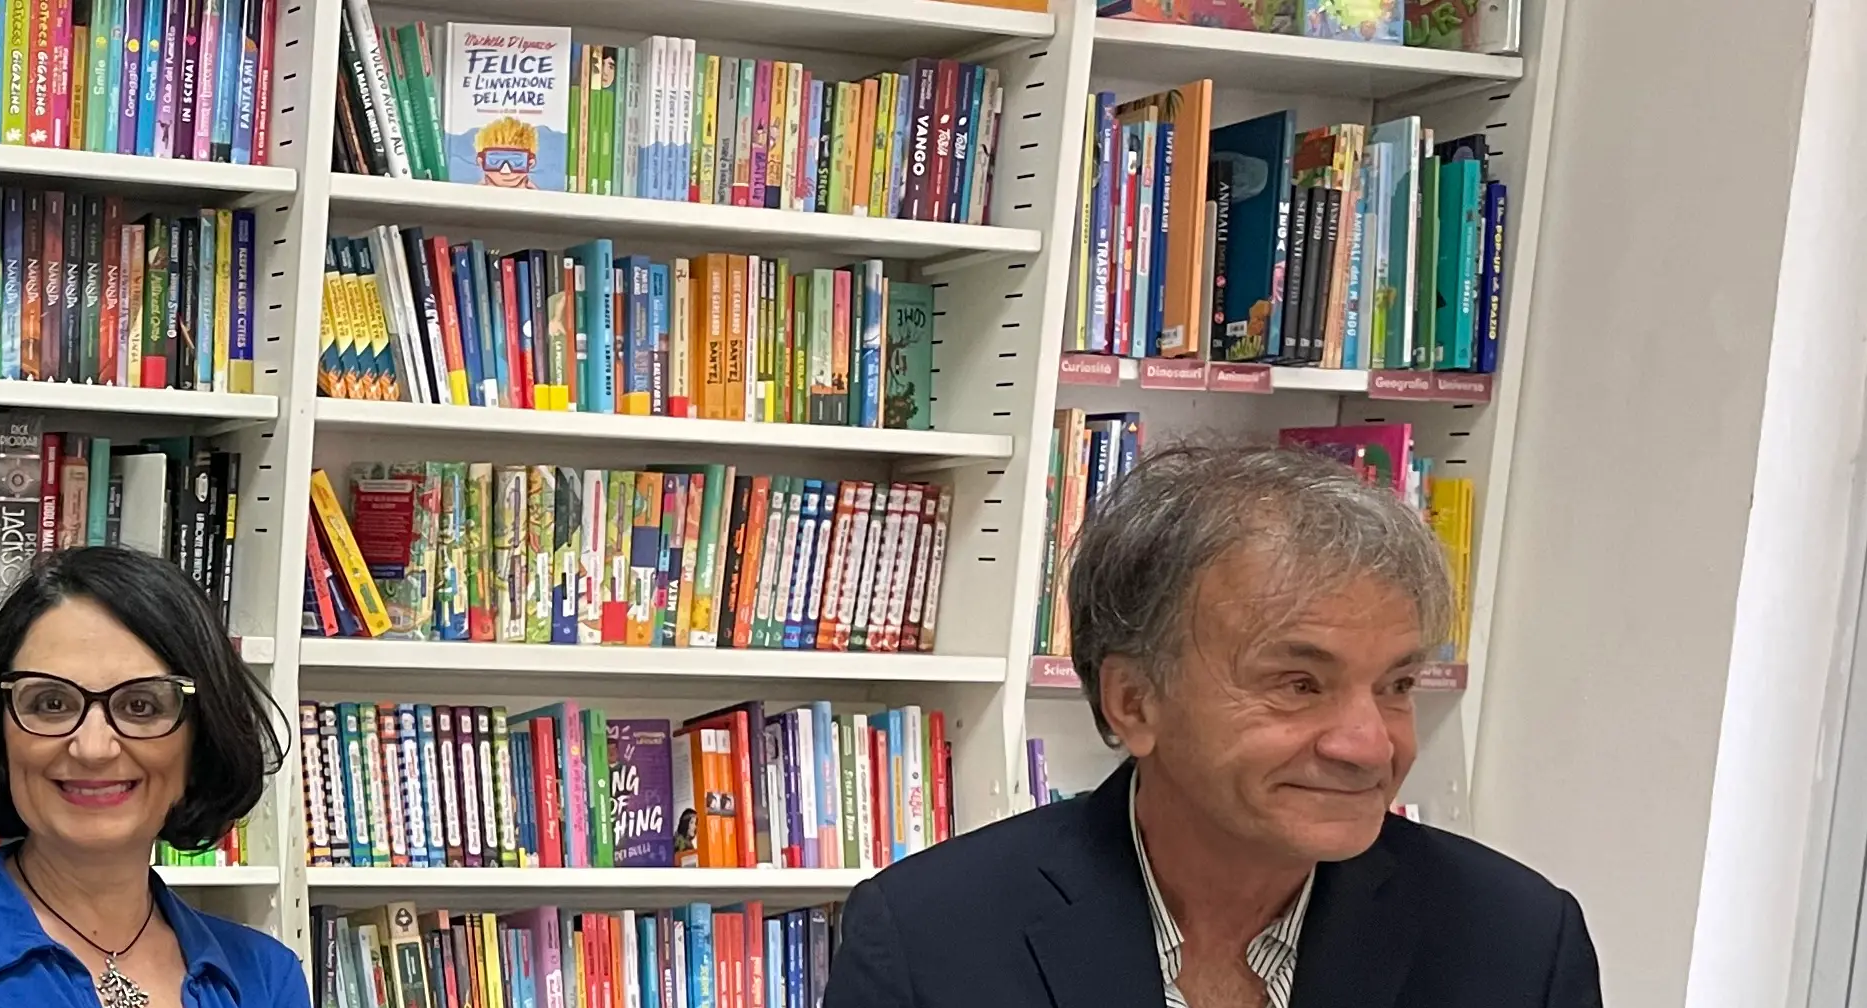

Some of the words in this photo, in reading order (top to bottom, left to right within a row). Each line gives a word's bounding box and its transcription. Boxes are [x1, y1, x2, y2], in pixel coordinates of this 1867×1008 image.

[353, 61, 364, 73] LA
[463, 76, 471, 88] E
[475, 76, 555, 90] L'INVENZIONE
[466, 50, 553, 74] FELICE
[124, 63, 136, 117] Coraggio
[240, 60, 253, 129] FANTASMI
[356, 73, 372, 109] MAGLIA
[473, 91, 499, 106] DEL
[502, 90, 545, 106] MARE
[182, 108, 191, 122] IN
[911, 115, 930, 176] VANGO
[1216, 182, 1231, 242] ANIMALI
[1275, 202, 1290, 251] MEGA
[1350, 212, 1363, 261] ANIMALI
[5, 259, 18, 304] NARNIA
[26, 258, 39, 304] NARNIA
[46, 261, 59, 306] NARNIA
[65, 263, 78, 309] NARNIA
[85, 262, 98, 307] NARNIA
[105, 264, 118, 310] NARNIA
[1094, 240, 1109, 315] TRASPORTI
[1487, 296, 1499, 339] SPAZIO
[1062, 359, 1112, 375] Curiosità
[1147, 365, 1203, 380] Dinosauri
[1375, 376, 1429, 393] Geografia
[1438, 379, 1484, 394] Universo
[11, 424, 28, 435] RICK
[44, 496, 56, 528] L'IDOLO
[2, 507, 24, 586] JACKSO
[667, 579, 679, 611] META
